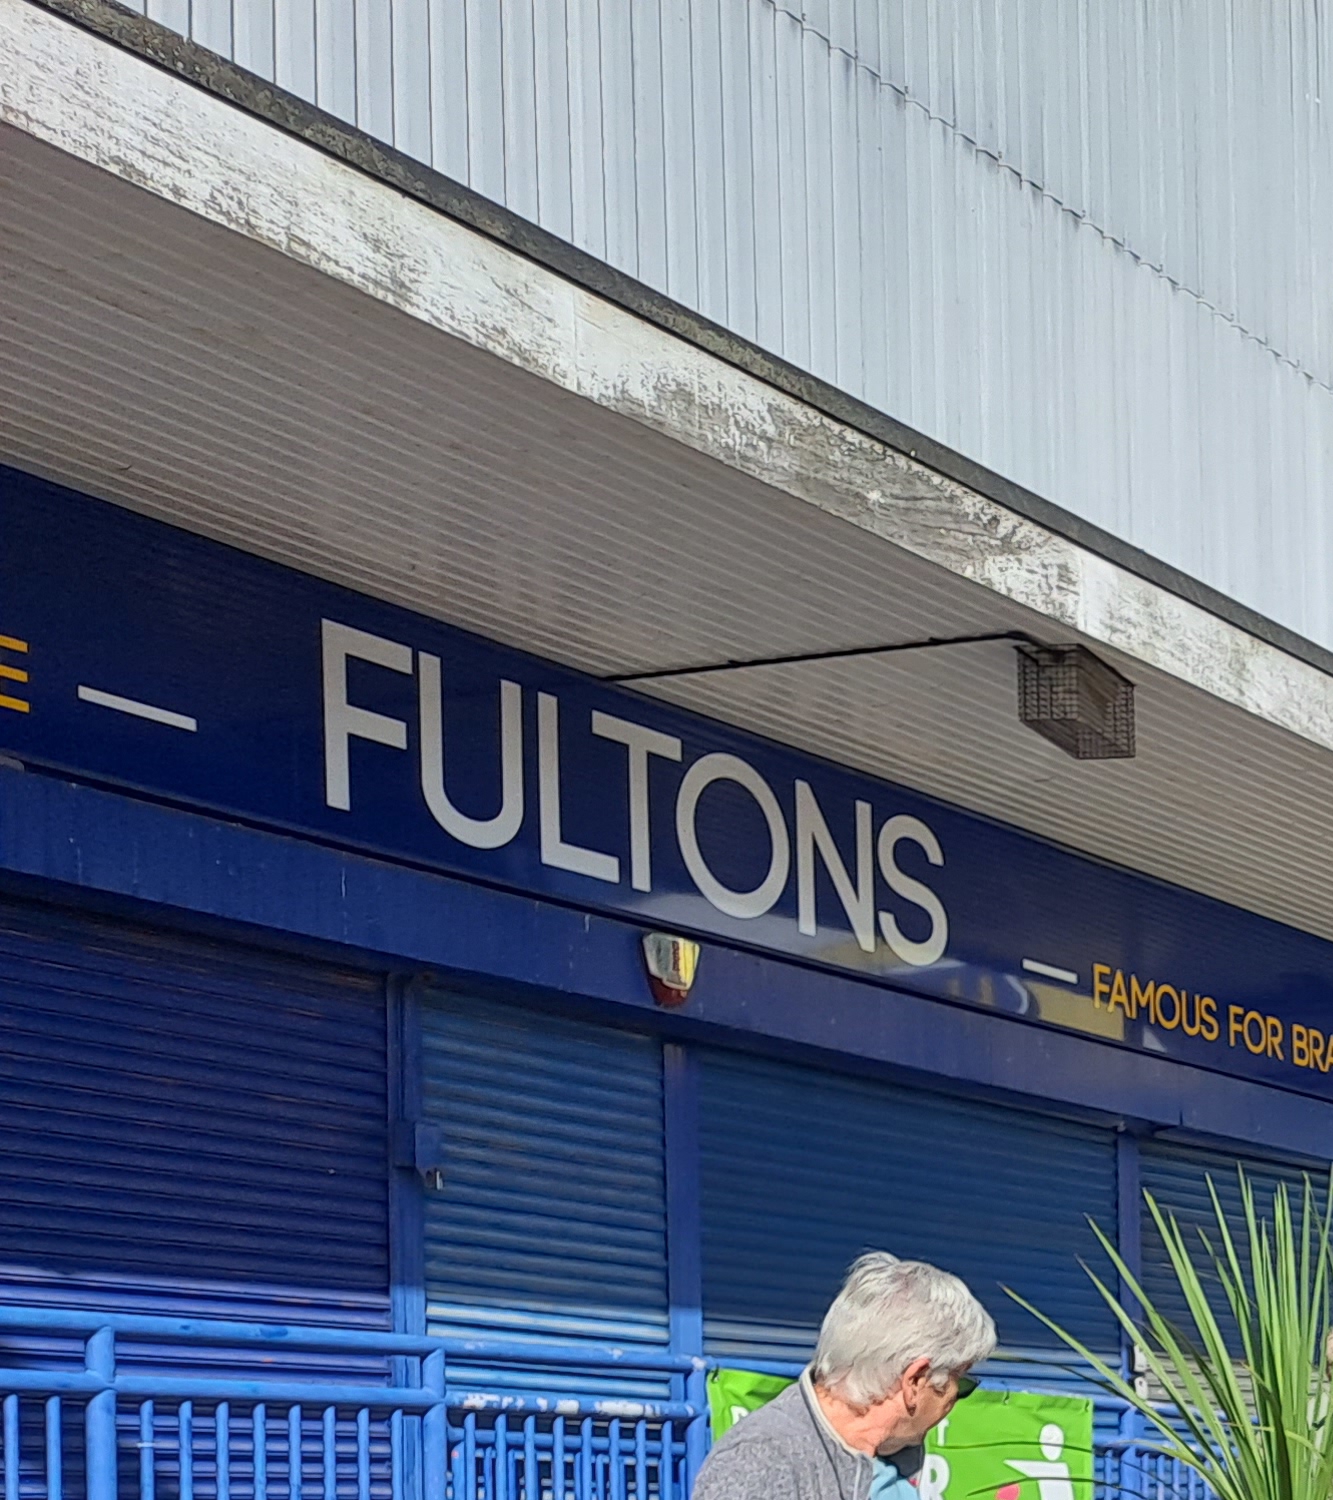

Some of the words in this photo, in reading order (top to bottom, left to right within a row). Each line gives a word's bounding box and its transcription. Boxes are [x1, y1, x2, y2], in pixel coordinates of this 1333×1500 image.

[320, 617, 949, 967] FULTONS
[1092, 962, 1219, 1041] FAMOUS
[1228, 1004, 1285, 1060] FOR
